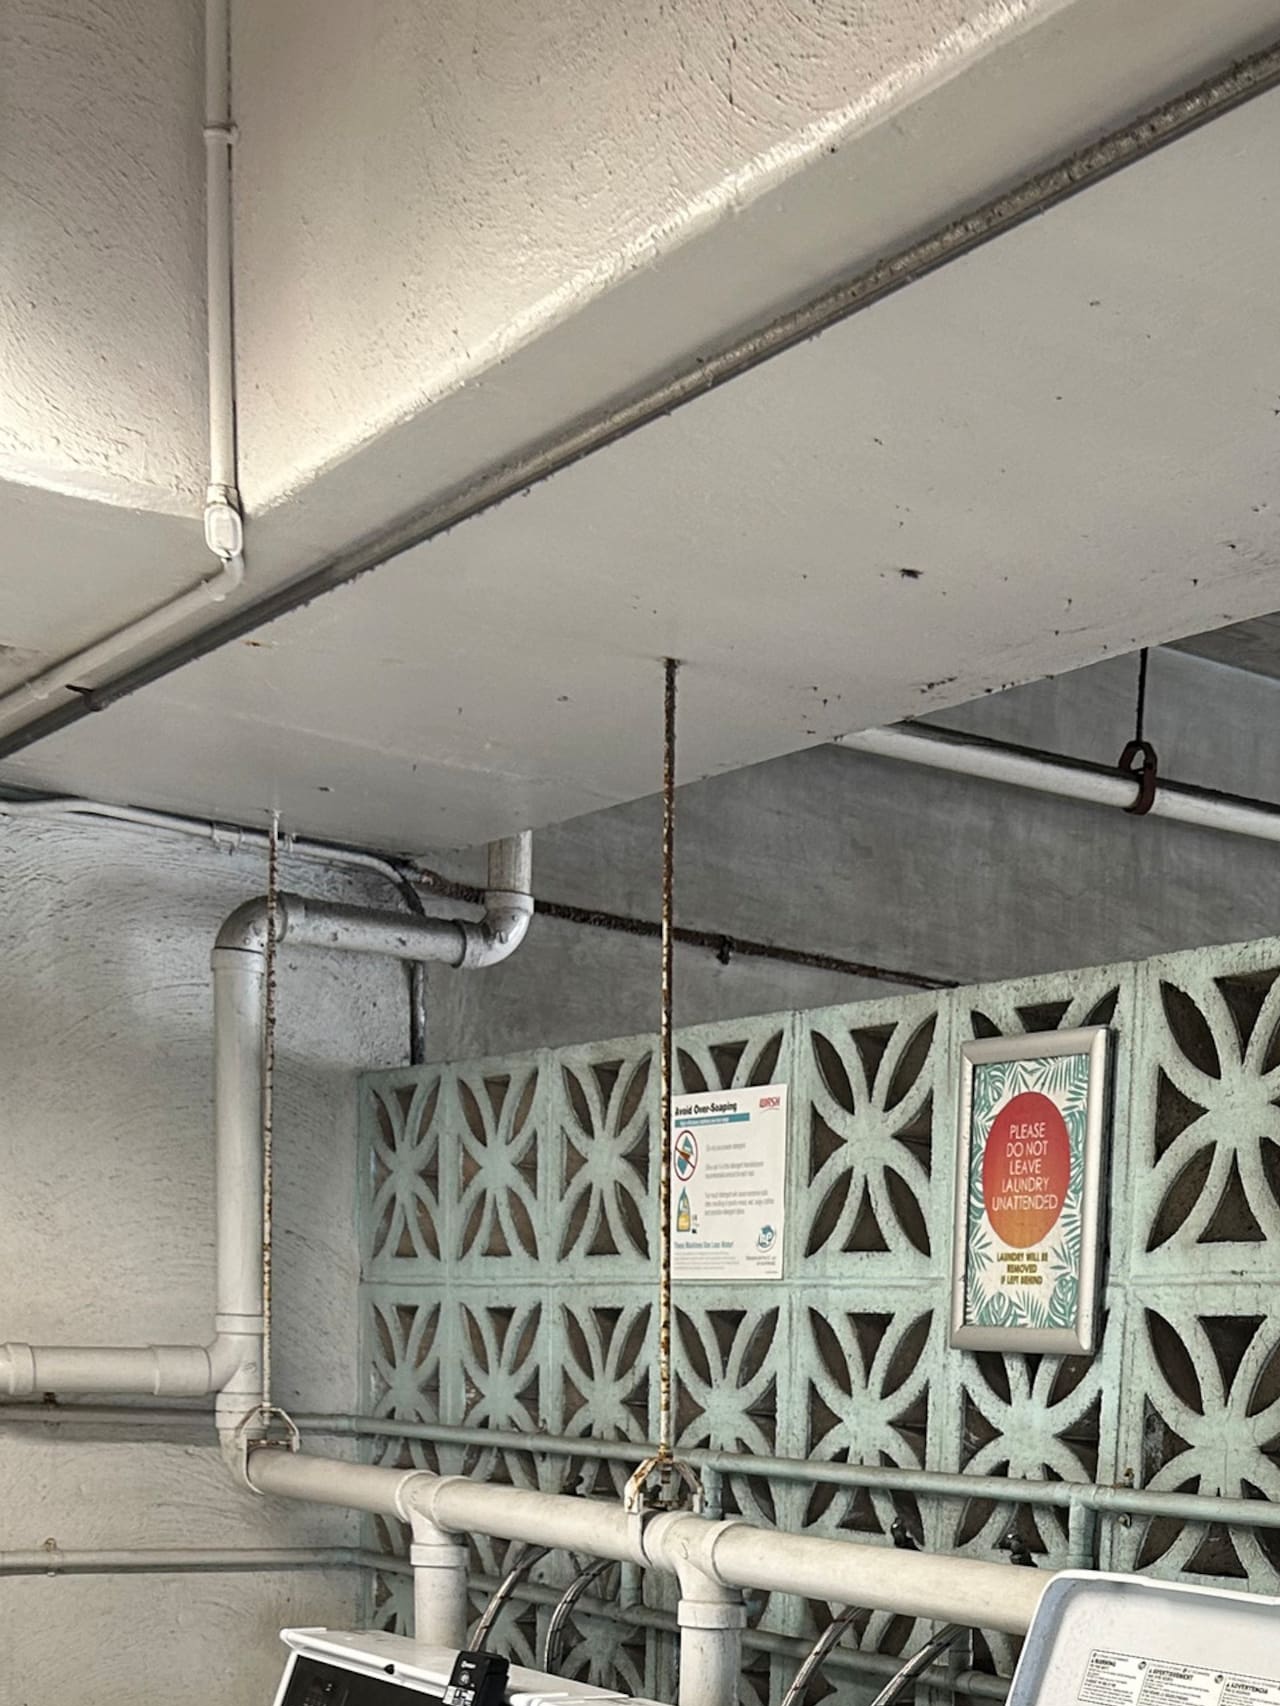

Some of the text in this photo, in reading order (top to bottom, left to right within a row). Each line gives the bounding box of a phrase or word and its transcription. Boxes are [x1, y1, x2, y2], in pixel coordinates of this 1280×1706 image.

[675, 1104, 692, 1116] Avoid
[1009, 1122, 1046, 1140] PLEASE
[1006, 1140, 1049, 1158] DO NOT
[1009, 1158, 1042, 1176] LEAVE
[1001, 1176, 1050, 1193] LAUNDRY
[991, 1193, 1058, 1212] UNATTENDED
